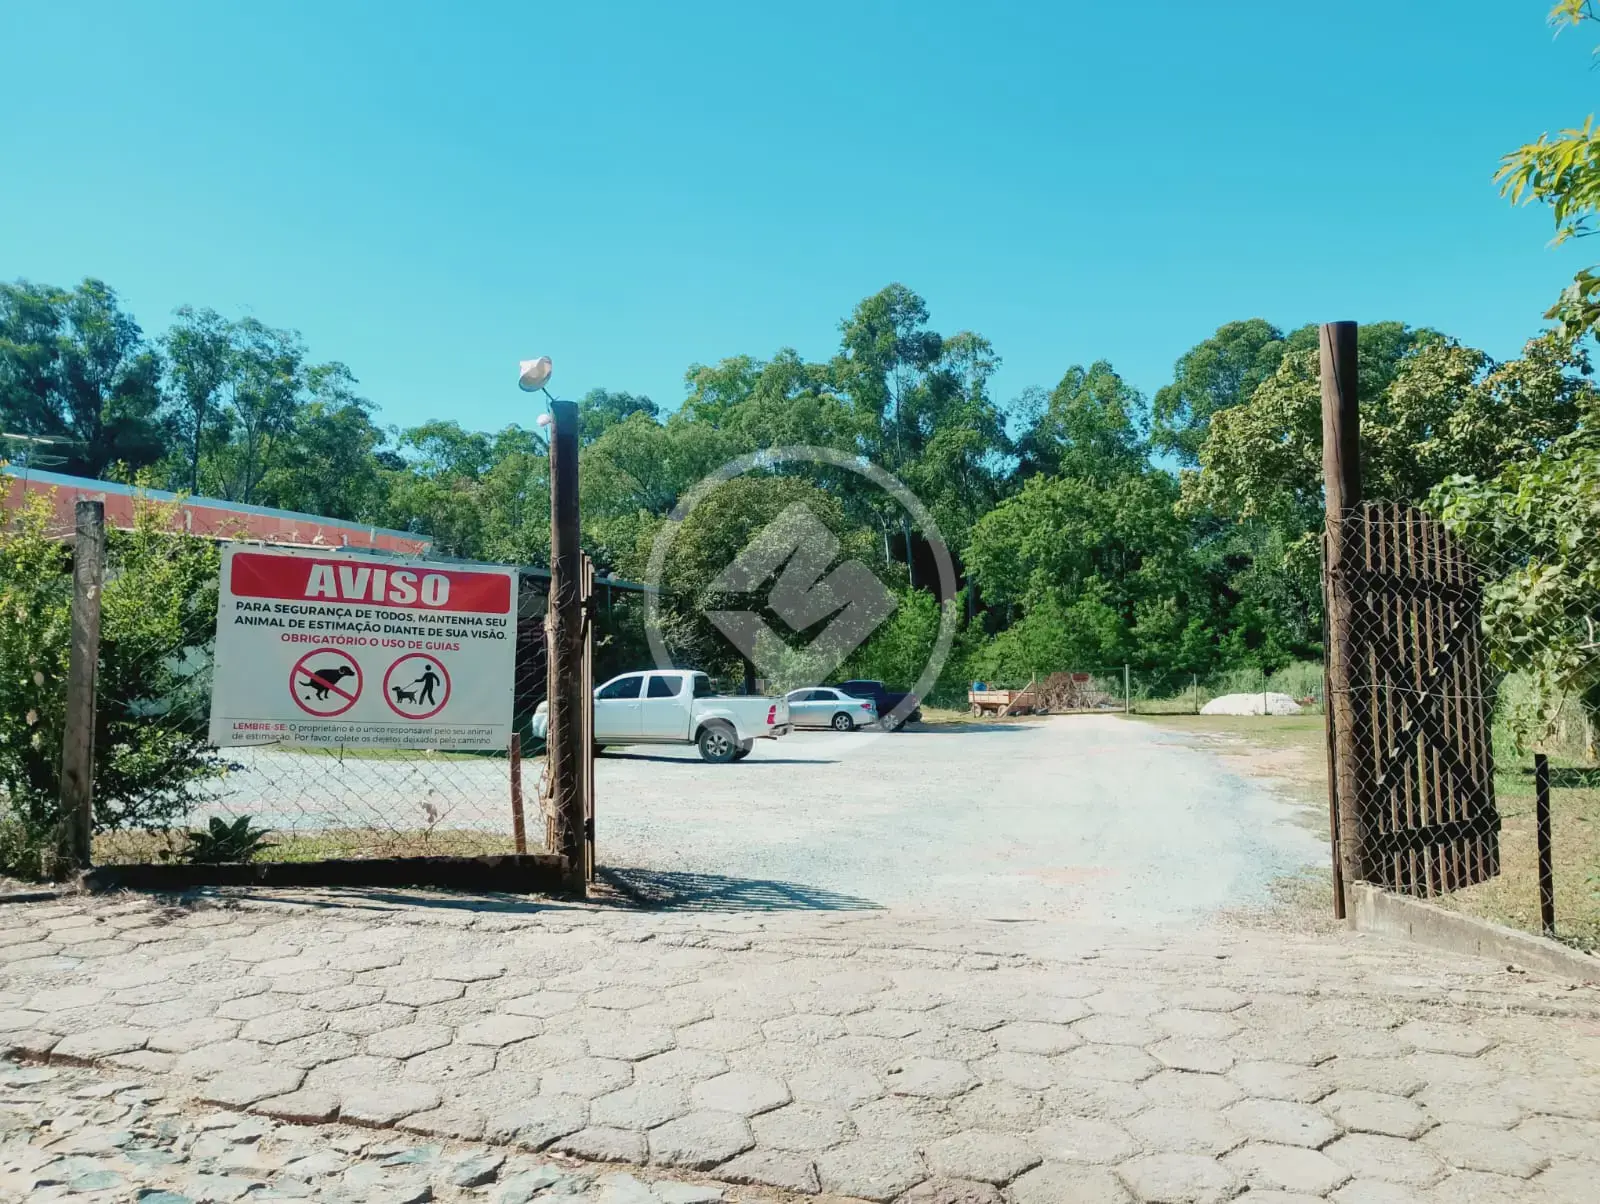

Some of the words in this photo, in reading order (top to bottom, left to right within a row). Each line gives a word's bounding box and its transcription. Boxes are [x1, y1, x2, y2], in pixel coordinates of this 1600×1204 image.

[304, 564, 450, 606] AVISO
[236, 602, 271, 612] PARA
[274, 604, 352, 619] SEGURANÇA
[356, 609, 371, 618] DE
[375, 610, 415, 622] TODOS,
[418, 614, 482, 626] MANTENHA
[486, 618, 506, 626] SEU
[234, 616, 285, 627] ANIMAL
[288, 618, 305, 628] DE
[308, 620, 381, 634] ESTIMAÇÃO
[384, 625, 425, 636] DIANTE
[428, 628, 443, 637] DE
[446, 628, 468, 638] SUA
[471, 629, 508, 640] VISÃO.
[281, 633, 367, 646] OBRIGATÓRIO
[370, 638, 378, 646] O
[382, 638, 405, 648] USO
[408, 640, 422, 650] DE
[426, 641, 460, 651] GUIAS
[289, 724, 296, 732] O
[298, 724, 347, 733] proprietário
[334, 734, 360, 742] colete
